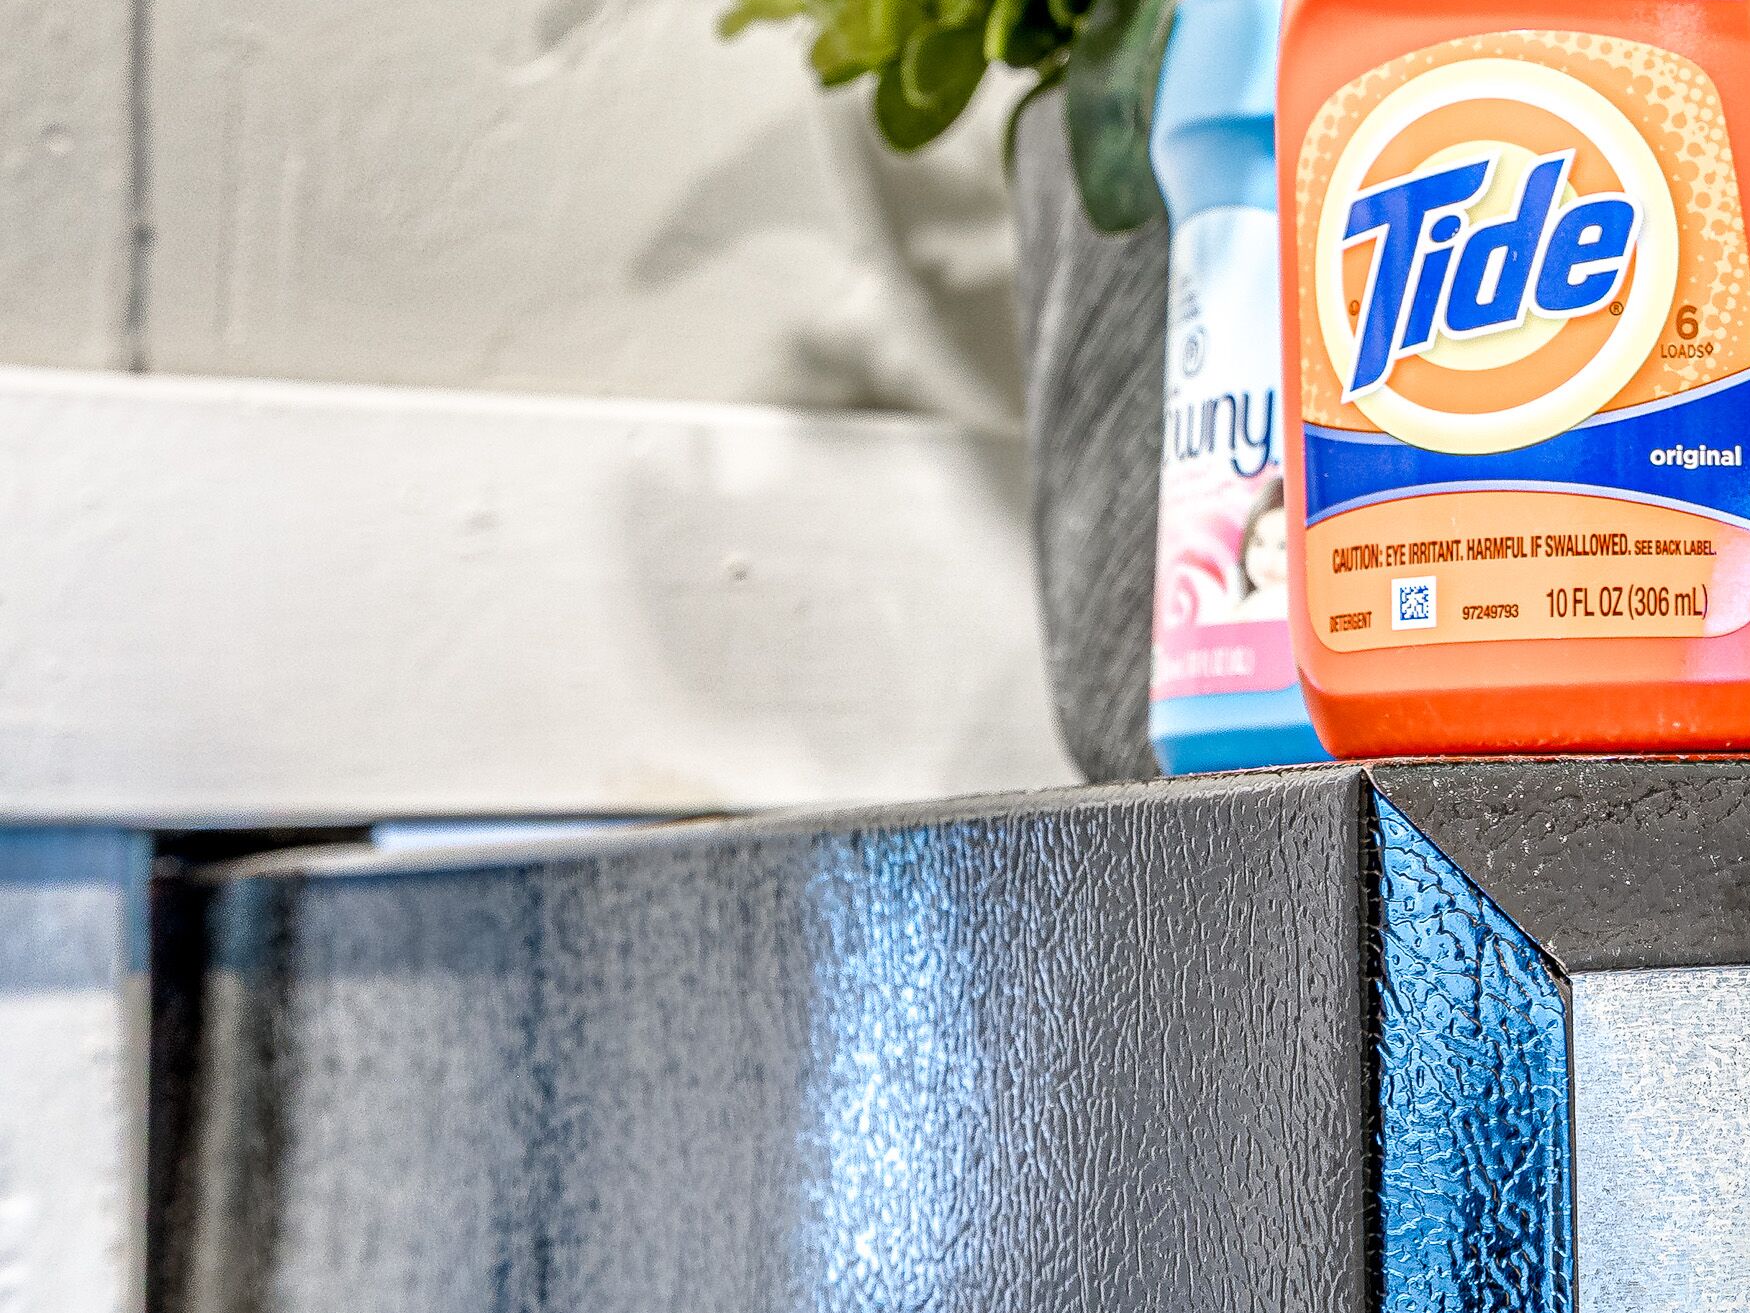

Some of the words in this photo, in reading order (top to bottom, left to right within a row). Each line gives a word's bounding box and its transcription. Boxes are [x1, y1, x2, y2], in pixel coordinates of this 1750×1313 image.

[1342, 157, 1637, 393] Tide
[1675, 304, 1699, 341] 6
[1650, 444, 1742, 470] original
[1332, 543, 1383, 574] CAUTION:
[1385, 543, 1407, 567] EYE
[1408, 539, 1463, 565] IRRITANT.
[1466, 536, 1527, 561] HARMFUL
[1530, 535, 1542, 558] IF
[1545, 533, 1631, 558] SWALLOWED.
[1634, 540, 1653, 556] SEE
[1655, 540, 1682, 556] BACK
[1684, 539, 1717, 556] LABEL.
[1461, 604, 1519, 620] 97249793
[1546, 588, 1568, 618] 10
[1572, 587, 1595, 617] FL
[1599, 586, 1624, 617] OZ
[1628, 584, 1670, 621] (306
[1674, 584, 1708, 620] mL)
[1330, 611, 1373, 633] DETERGENT
